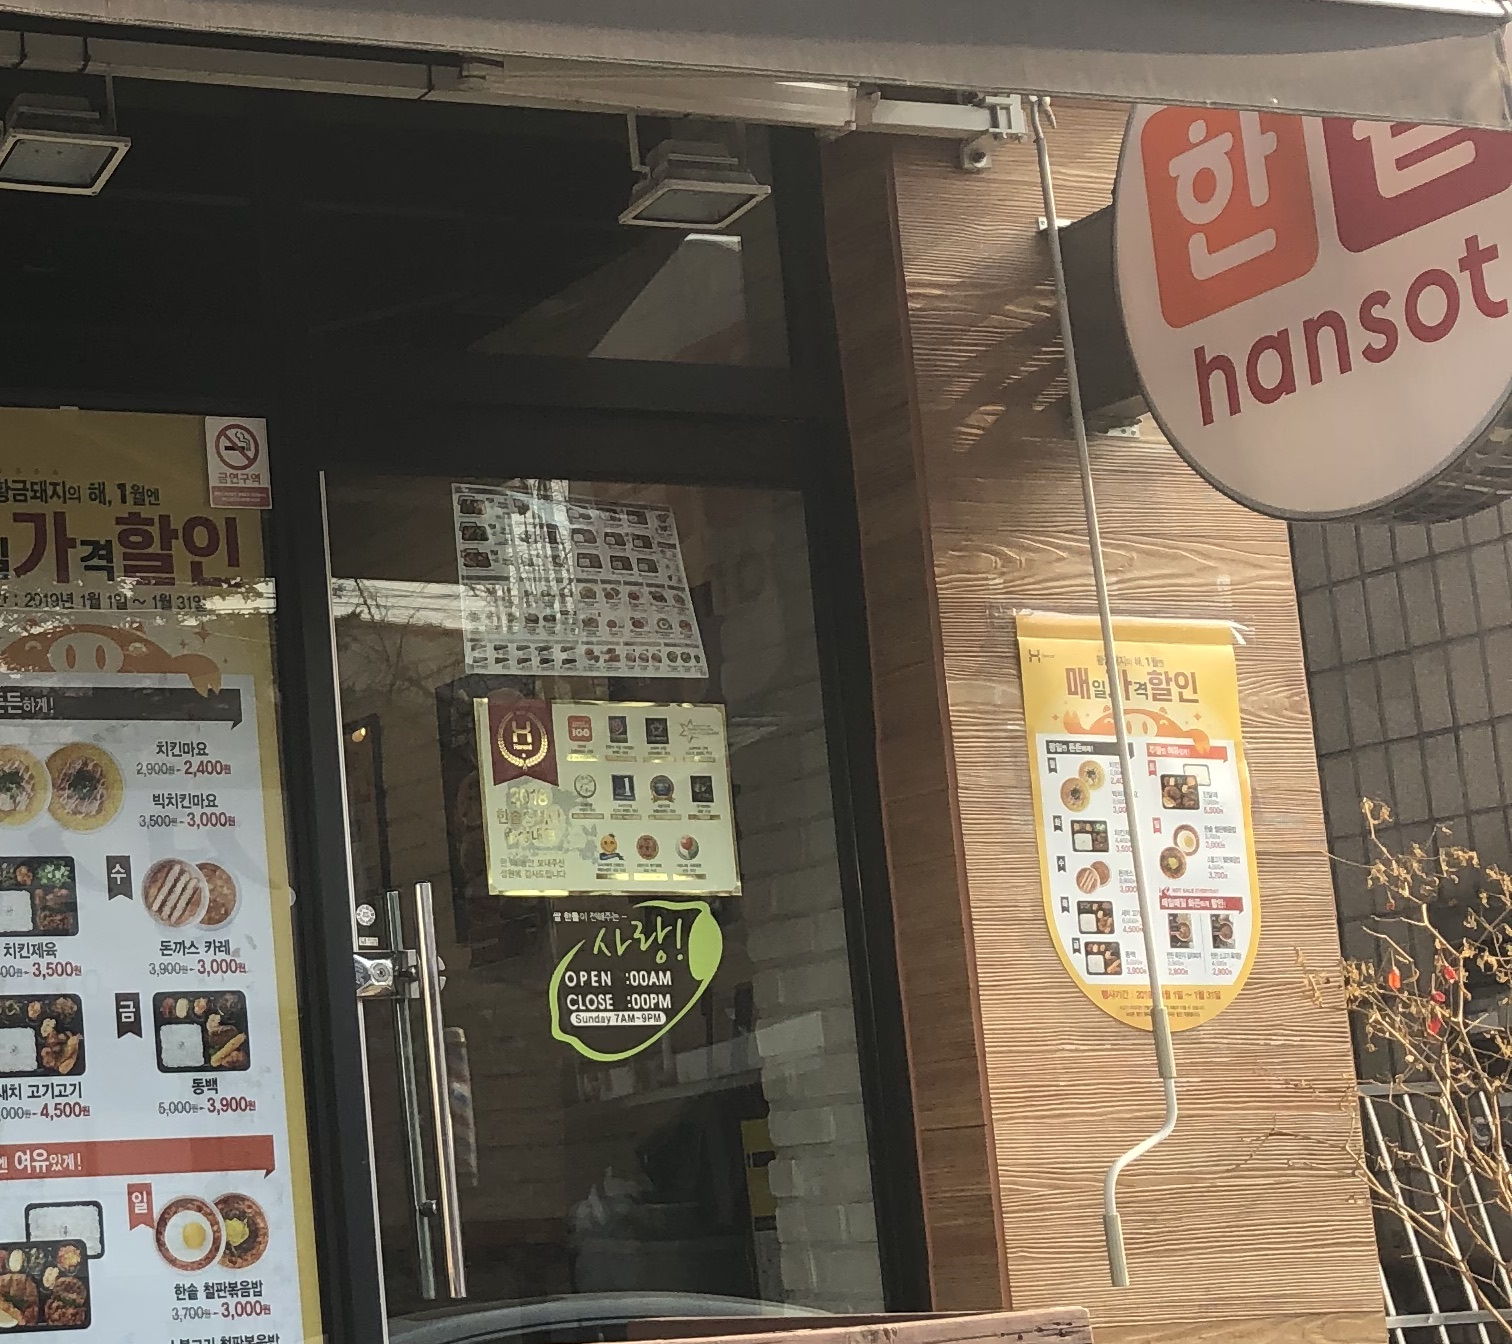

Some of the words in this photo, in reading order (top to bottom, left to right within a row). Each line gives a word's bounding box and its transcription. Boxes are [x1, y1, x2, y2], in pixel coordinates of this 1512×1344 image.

[1194, 234, 1509, 426] hansot
[218, 472, 261, 485] 금연구역
[117, 483, 161, 505] 1월엔
[156, 741, 209, 757] 치킨마요
[184, 760, 231, 778] 2,400원
[152, 793, 218, 810] 빅치킨마요
[111, 864, 127, 884] 수
[4, 942, 58, 959] 치킨제육
[160, 939, 200, 956] 돈까스
[205, 939, 231, 956] 카레
[32, 961, 82, 980] 3,500원
[565, 971, 612, 986] OPEN
[567, 994, 614, 1010] CLOSE
[119, 1001, 135, 1022] 금
[575, 1014, 611, 1024] Sunday
[27, 1082, 82, 1099] 고기고기
[192, 1077, 218, 1095] 동백
[40, 1102, 90, 1121] 4,500원
[15, 1149, 82, 1173] 여유있게!
[132, 1191, 148, 1213] 일
[203, 1280, 263, 1299] 철판볶음밥
